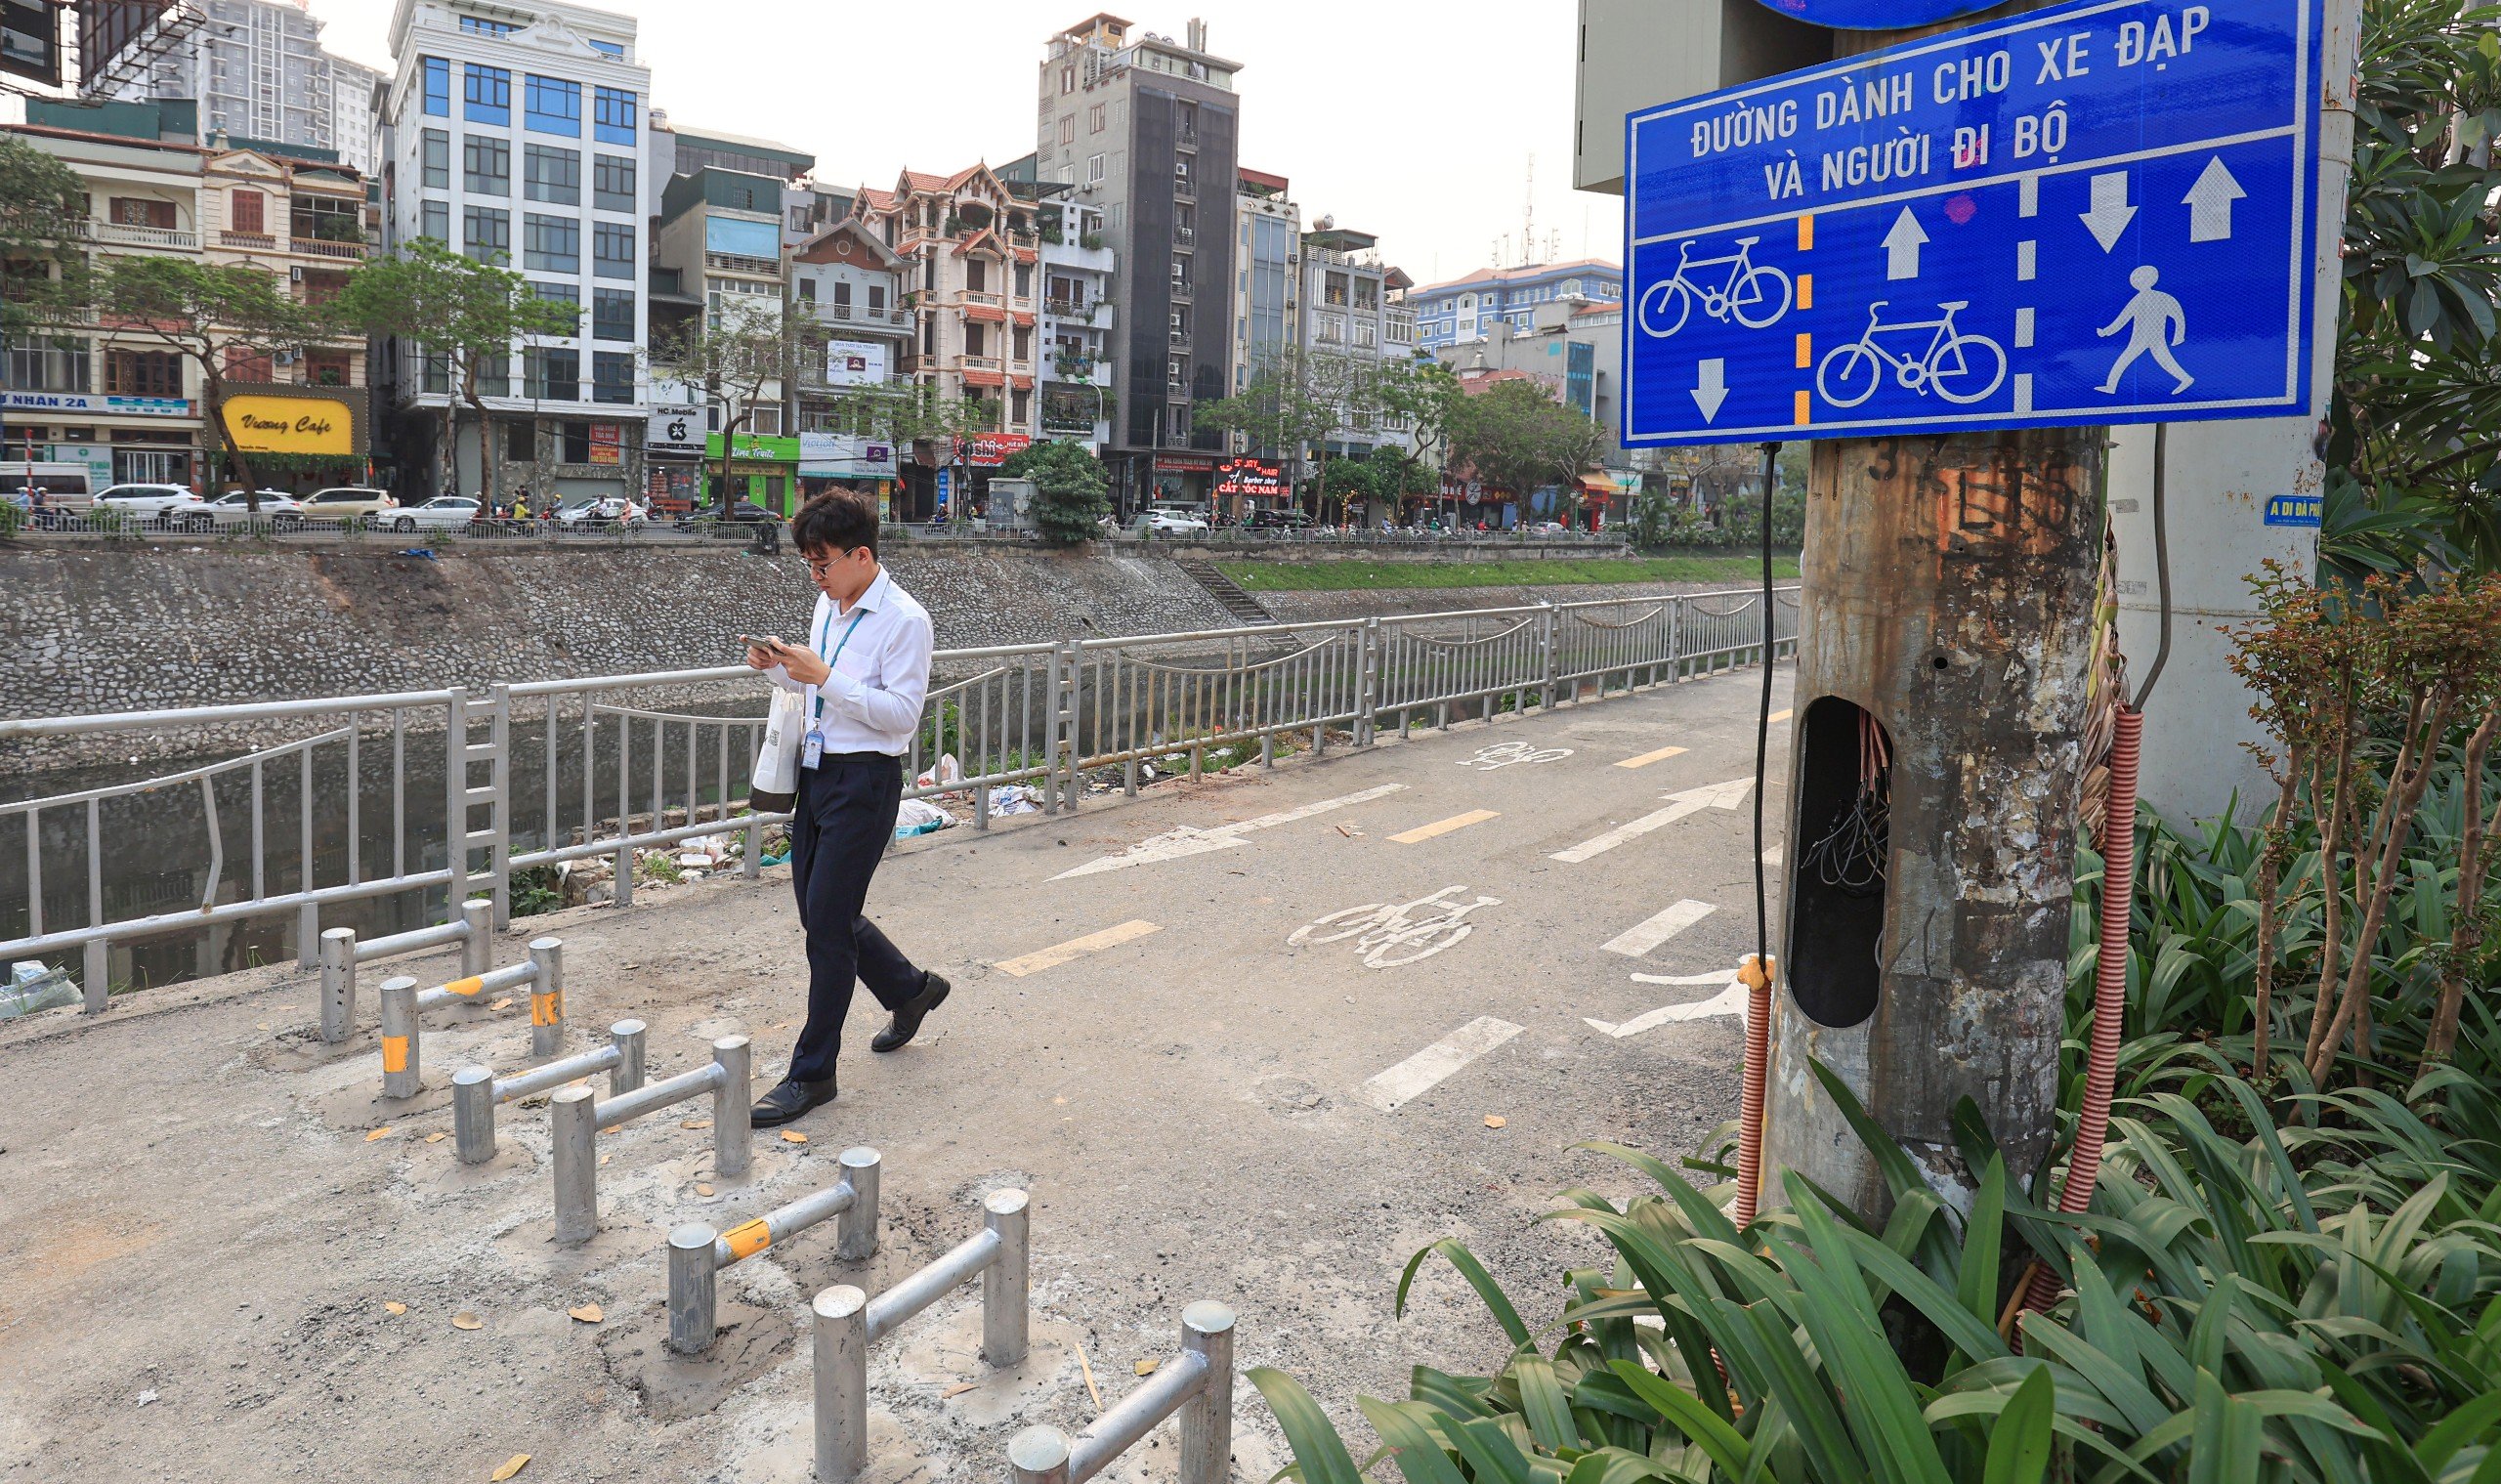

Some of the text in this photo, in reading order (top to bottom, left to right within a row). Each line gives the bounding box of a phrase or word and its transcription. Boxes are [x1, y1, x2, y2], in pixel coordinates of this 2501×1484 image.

[1690, 4, 2210, 158] ĐƯỜNG DÀNH CHO XE ĐẠP
[1763, 100, 2068, 201] VÀ NGƯỜI ĐI BỘ
[12, 393, 59, 406] NHÂN
[65, 398, 88, 408] 2A
[671, 407, 697, 416] Mobile
[295, 415, 331, 436] Cafe
[1234, 458, 1258, 469] SRY
[1261, 468, 1279, 477] HAIR
[1218, 480, 1238, 493] CẮT
[1258, 486, 1278, 494] NAM
[1264, 478, 1277, 487] shop
[1450, 485, 1462, 496] HẾ
[2269, 501, 2279, 516] A
[2281, 501, 2294, 517] DI
[2295, 499, 2308, 517] ĐÀ
